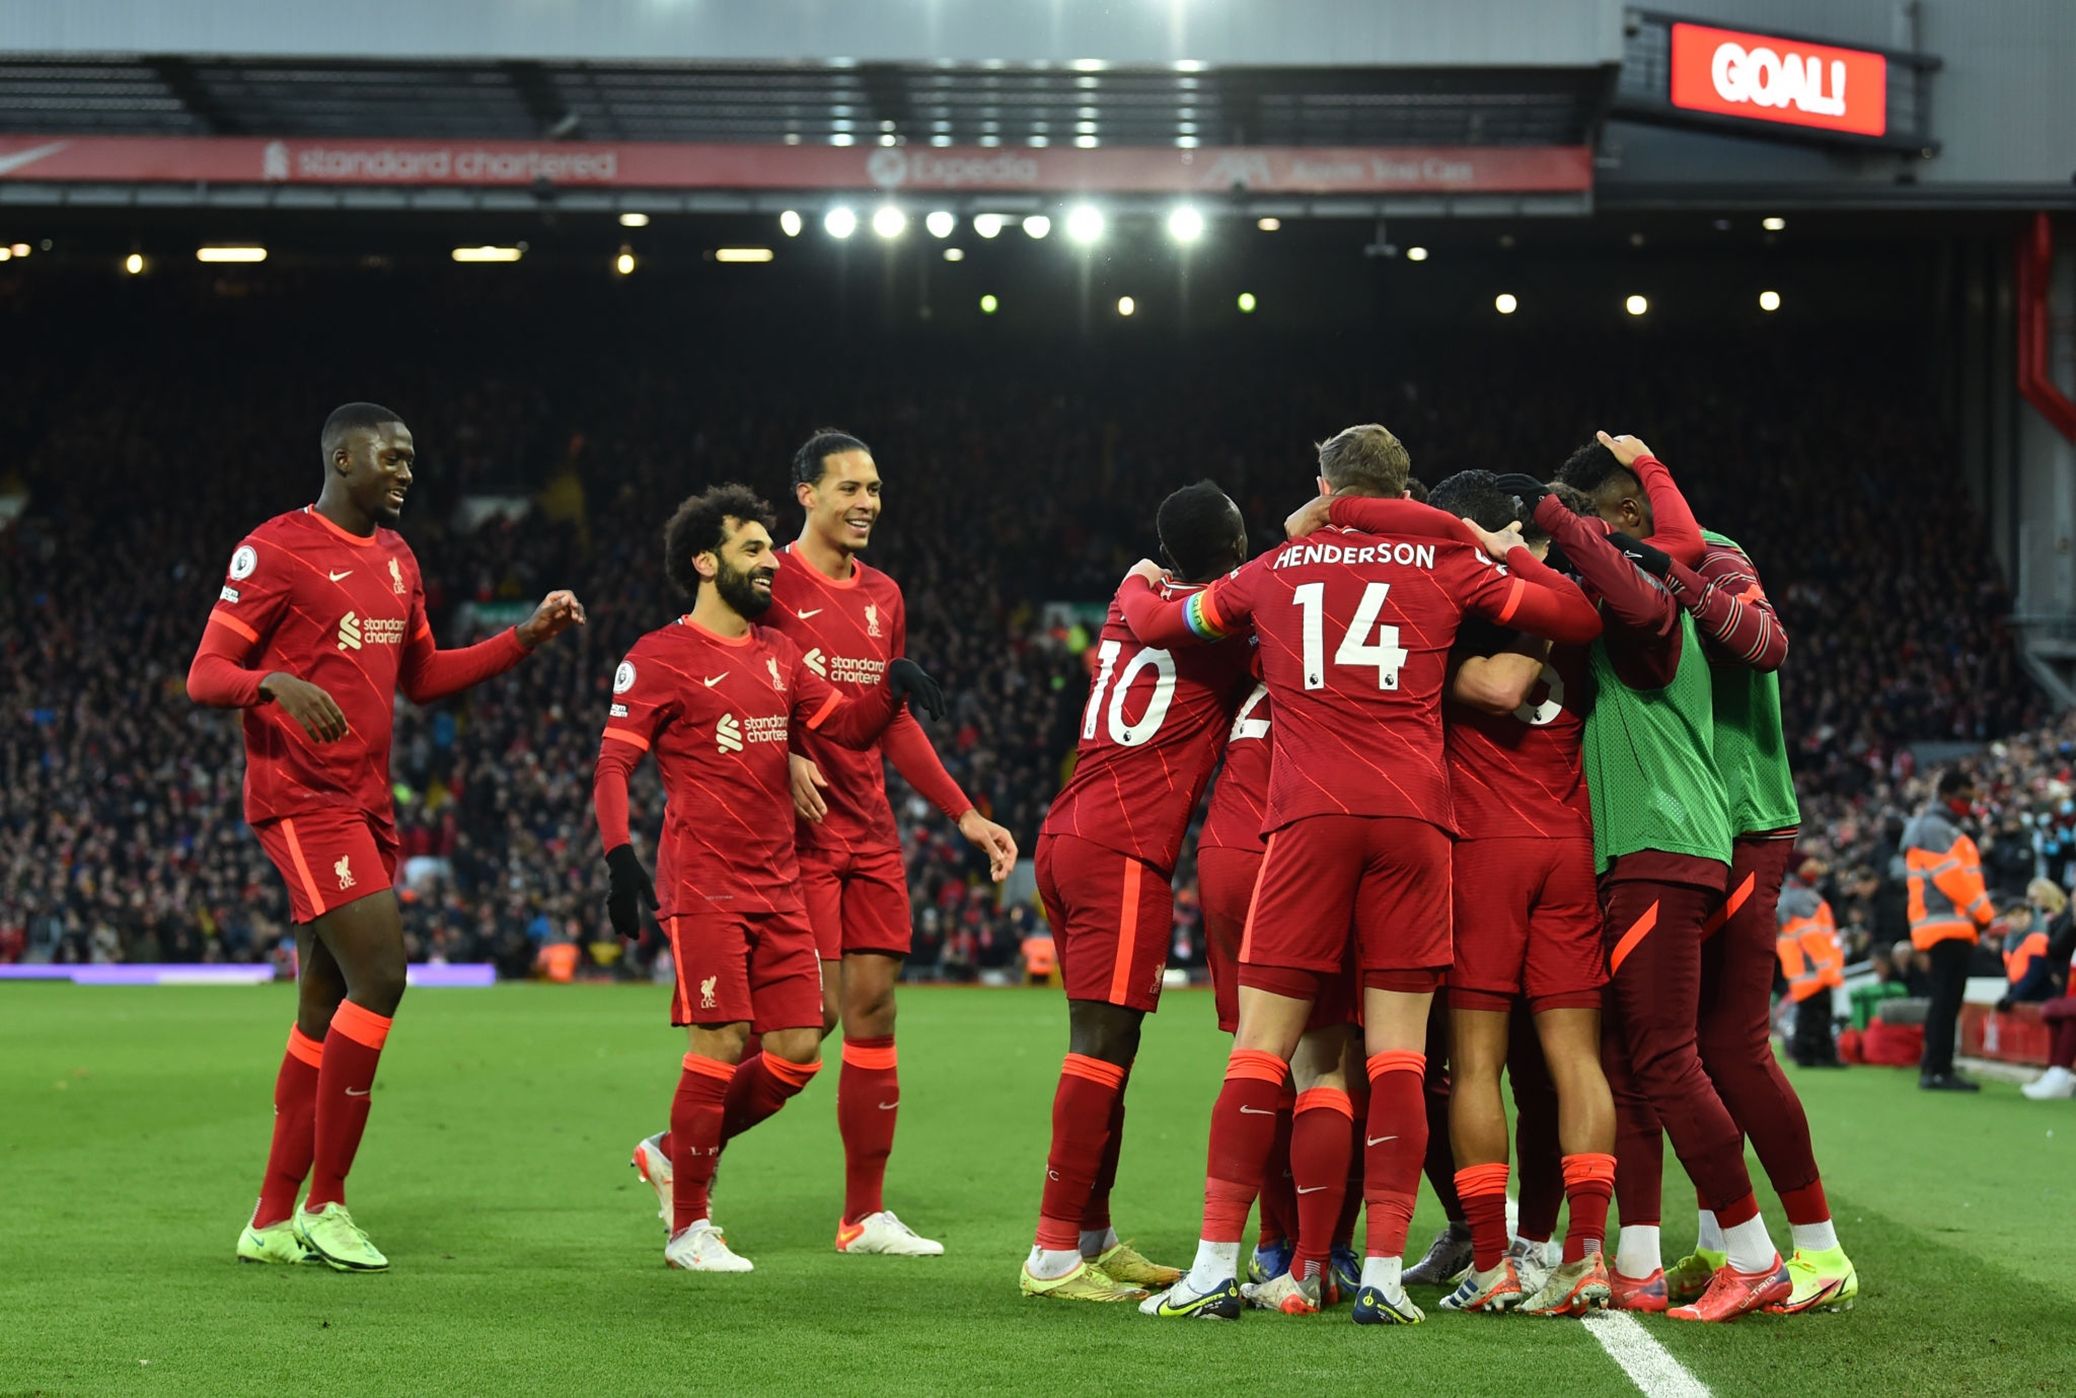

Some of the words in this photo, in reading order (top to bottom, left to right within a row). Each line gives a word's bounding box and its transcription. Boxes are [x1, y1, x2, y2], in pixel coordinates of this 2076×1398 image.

[1711, 42, 1847, 116] GOAL!
[299, 148, 450, 179] standard
[454, 150, 618, 180] chartered
[911, 153, 1038, 185] Expedia
[1273, 543, 1436, 570] HENDERSON
[1292, 582, 1409, 691] 14
[1083, 640, 1177, 747] 10
